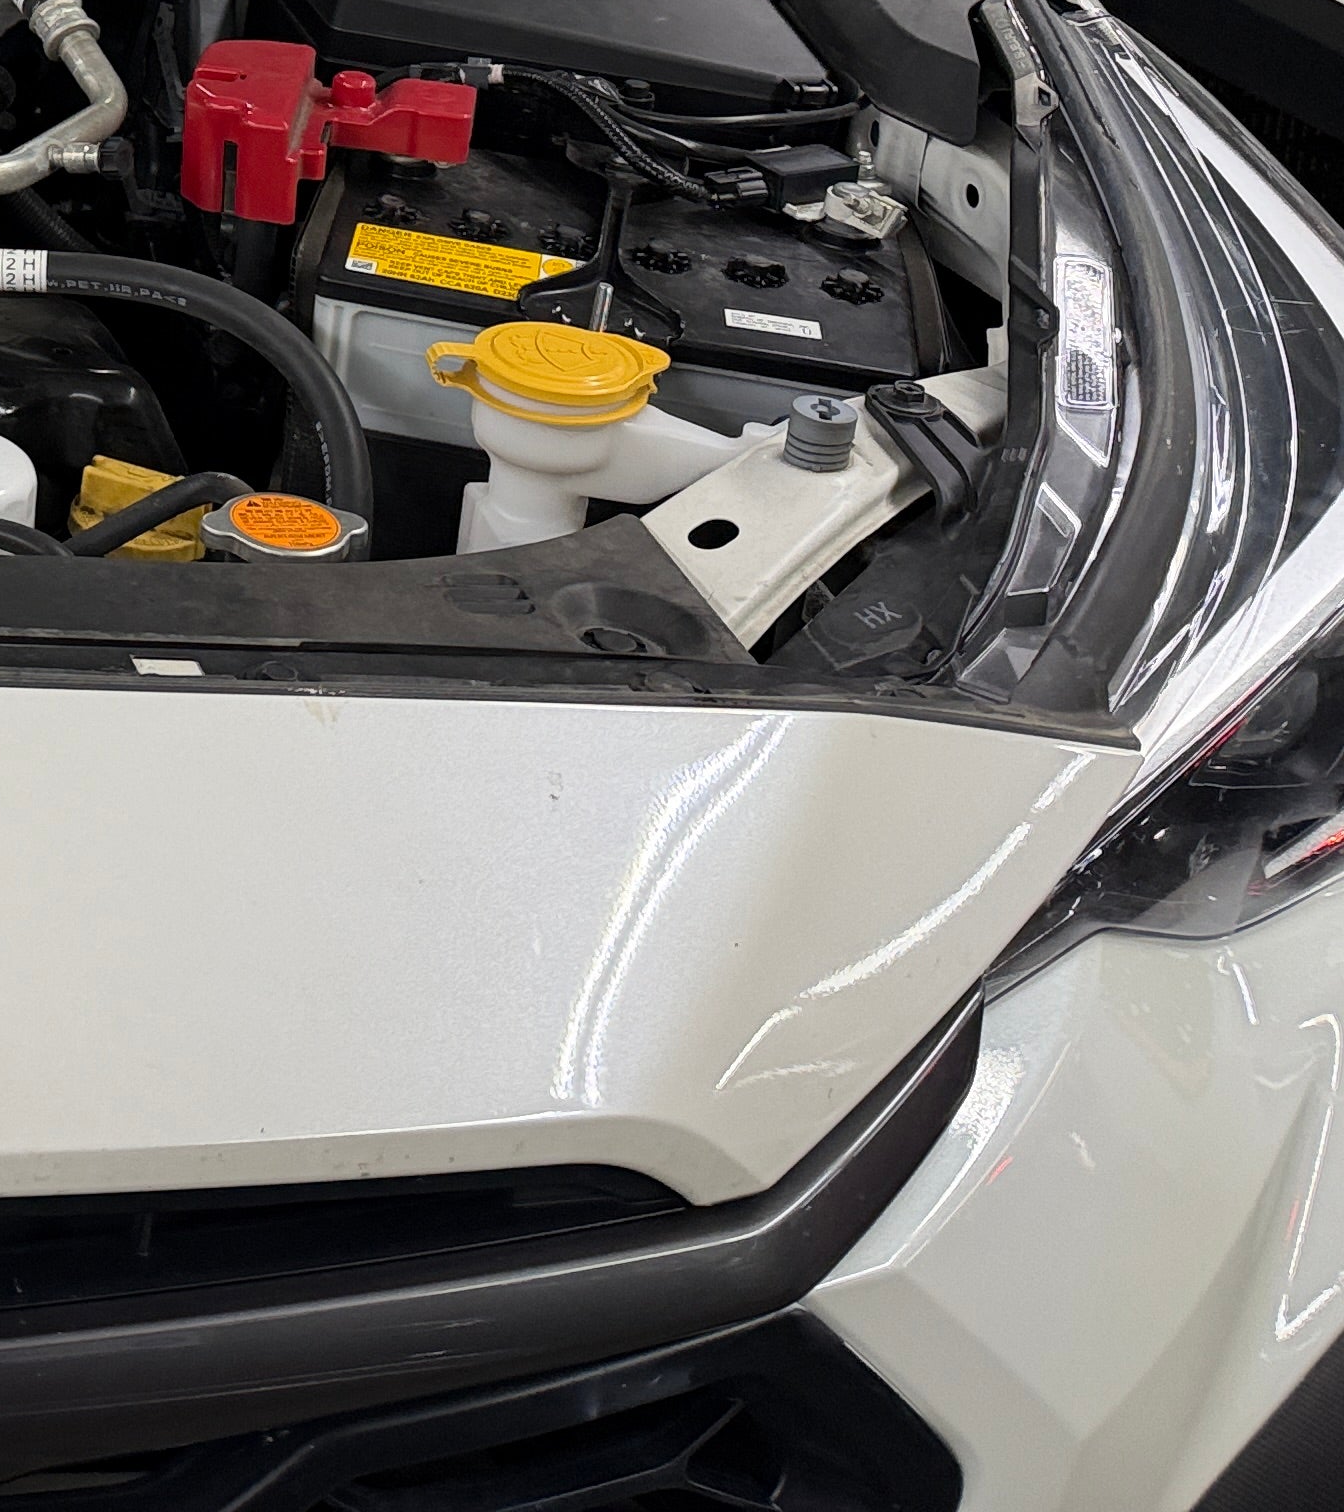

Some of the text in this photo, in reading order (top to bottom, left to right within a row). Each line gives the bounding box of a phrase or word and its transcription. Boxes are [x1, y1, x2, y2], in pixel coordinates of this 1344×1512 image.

[356, 240, 406, 255] POISON
[5, 257, 36, 271] 2 H
[5, 272, 17, 285] 2
[23, 273, 36, 285] H
[853, 600, 903, 630] HX
